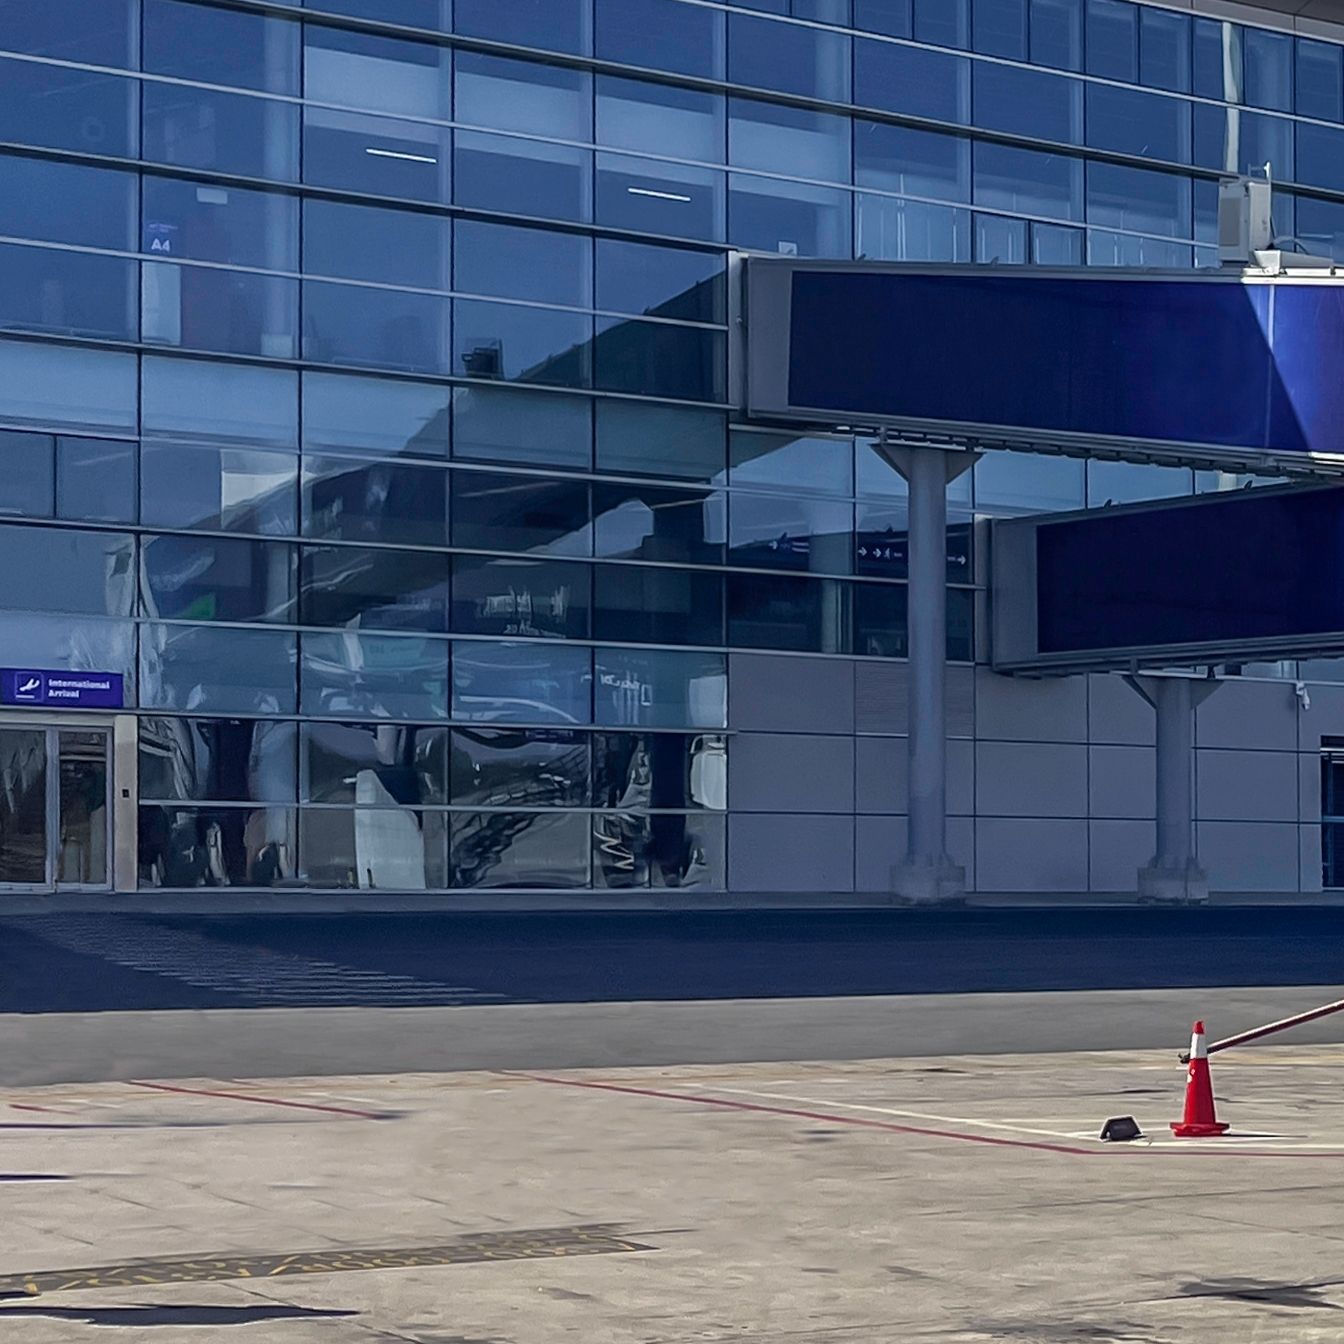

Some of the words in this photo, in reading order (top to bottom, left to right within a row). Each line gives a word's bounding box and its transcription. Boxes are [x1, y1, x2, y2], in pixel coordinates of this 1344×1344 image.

[151, 238, 170, 252] A4
[48, 679, 110, 689] International
[48, 690, 80, 698] Arrival
